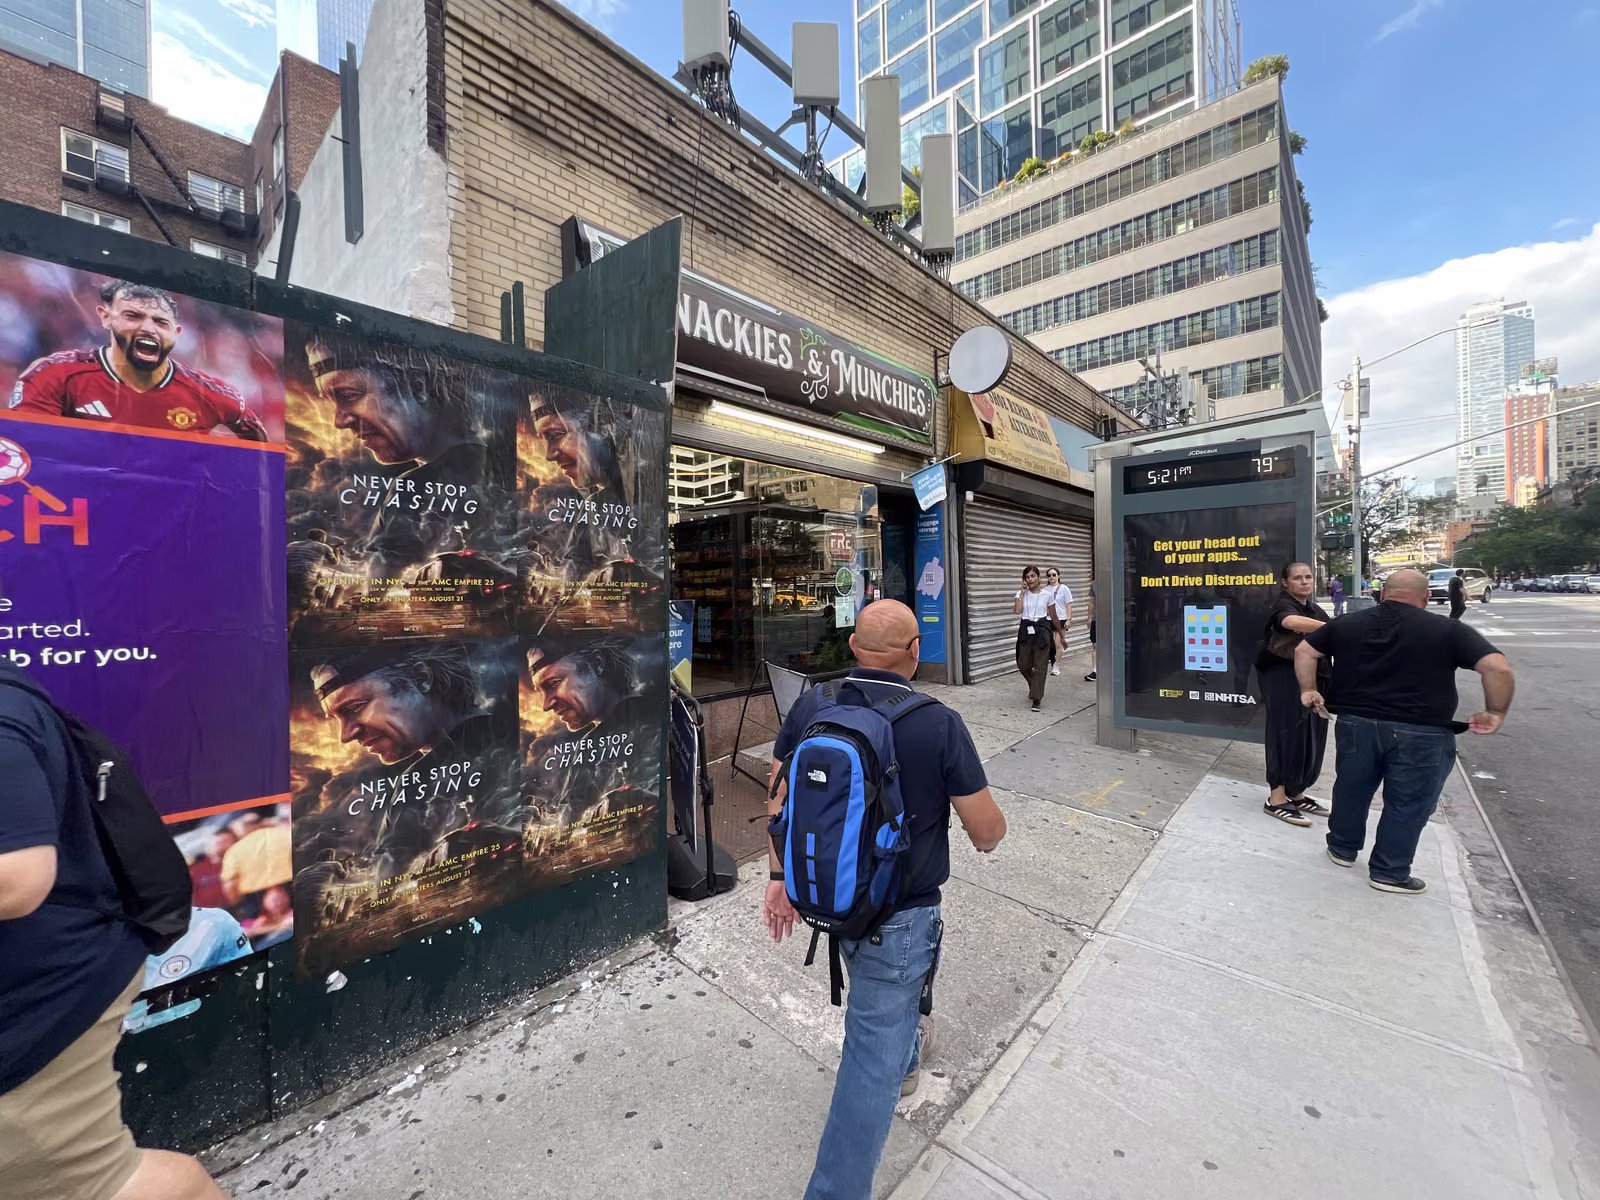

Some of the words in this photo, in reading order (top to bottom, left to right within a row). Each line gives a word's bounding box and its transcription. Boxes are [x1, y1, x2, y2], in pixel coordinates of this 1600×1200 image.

[808, 349, 823, 377] &
[831, 349, 927, 417] MUNCHIES
[1147, 468, 1177, 484] 5:21
[1179, 466, 1192, 475] PM
[353, 474, 416, 493] NEVER
[425, 482, 468, 498] STOP
[340, 489, 479, 514] CHASING
[557, 497, 597, 512] NEVER
[602, 503, 631, 515] STOP
[548, 509, 638, 529] CHASING
[1153, 541, 1173, 551] Get
[1175, 540, 1202, 551] your
[1204, 536, 1235, 549] head
[1238, 536, 1260, 547] out
[1165, 553, 1176, 564] of
[1178, 553, 1205, 564] your
[1207, 551, 1247, 563] apps...
[371, 578, 383, 586] IN
[431, 578, 453, 586] AMC
[484, 578, 495, 586] 25
[1141, 576, 1169, 587] Don't
[1171, 575, 1203, 586] Drive
[1205, 573, 1277, 586] Distracted.
[0, 619, 90, 639] arted.
[669, 629, 684, 637] our
[40, 648, 86, 665] for
[94, 648, 157, 666] you.
[1215, 692, 1256, 704] NHTSA
[554, 739, 593, 754] NEVER
[599, 733, 628, 746] STOP
[544, 743, 634, 770] CHASING
[361, 772, 421, 795] NEVER
[430, 761, 471, 780] STOP
[348, 772, 482, 816] CHASING
[380, 878, 391, 887] IN
[439, 856, 459, 868] AMC
[461, 847, 489, 861] EMPIRE
[491, 843, 501, 852] 25
[369, 897, 390, 908] ONLY
[436, 872, 463, 886] AUGUST
[464, 869, 472, 877] 21
